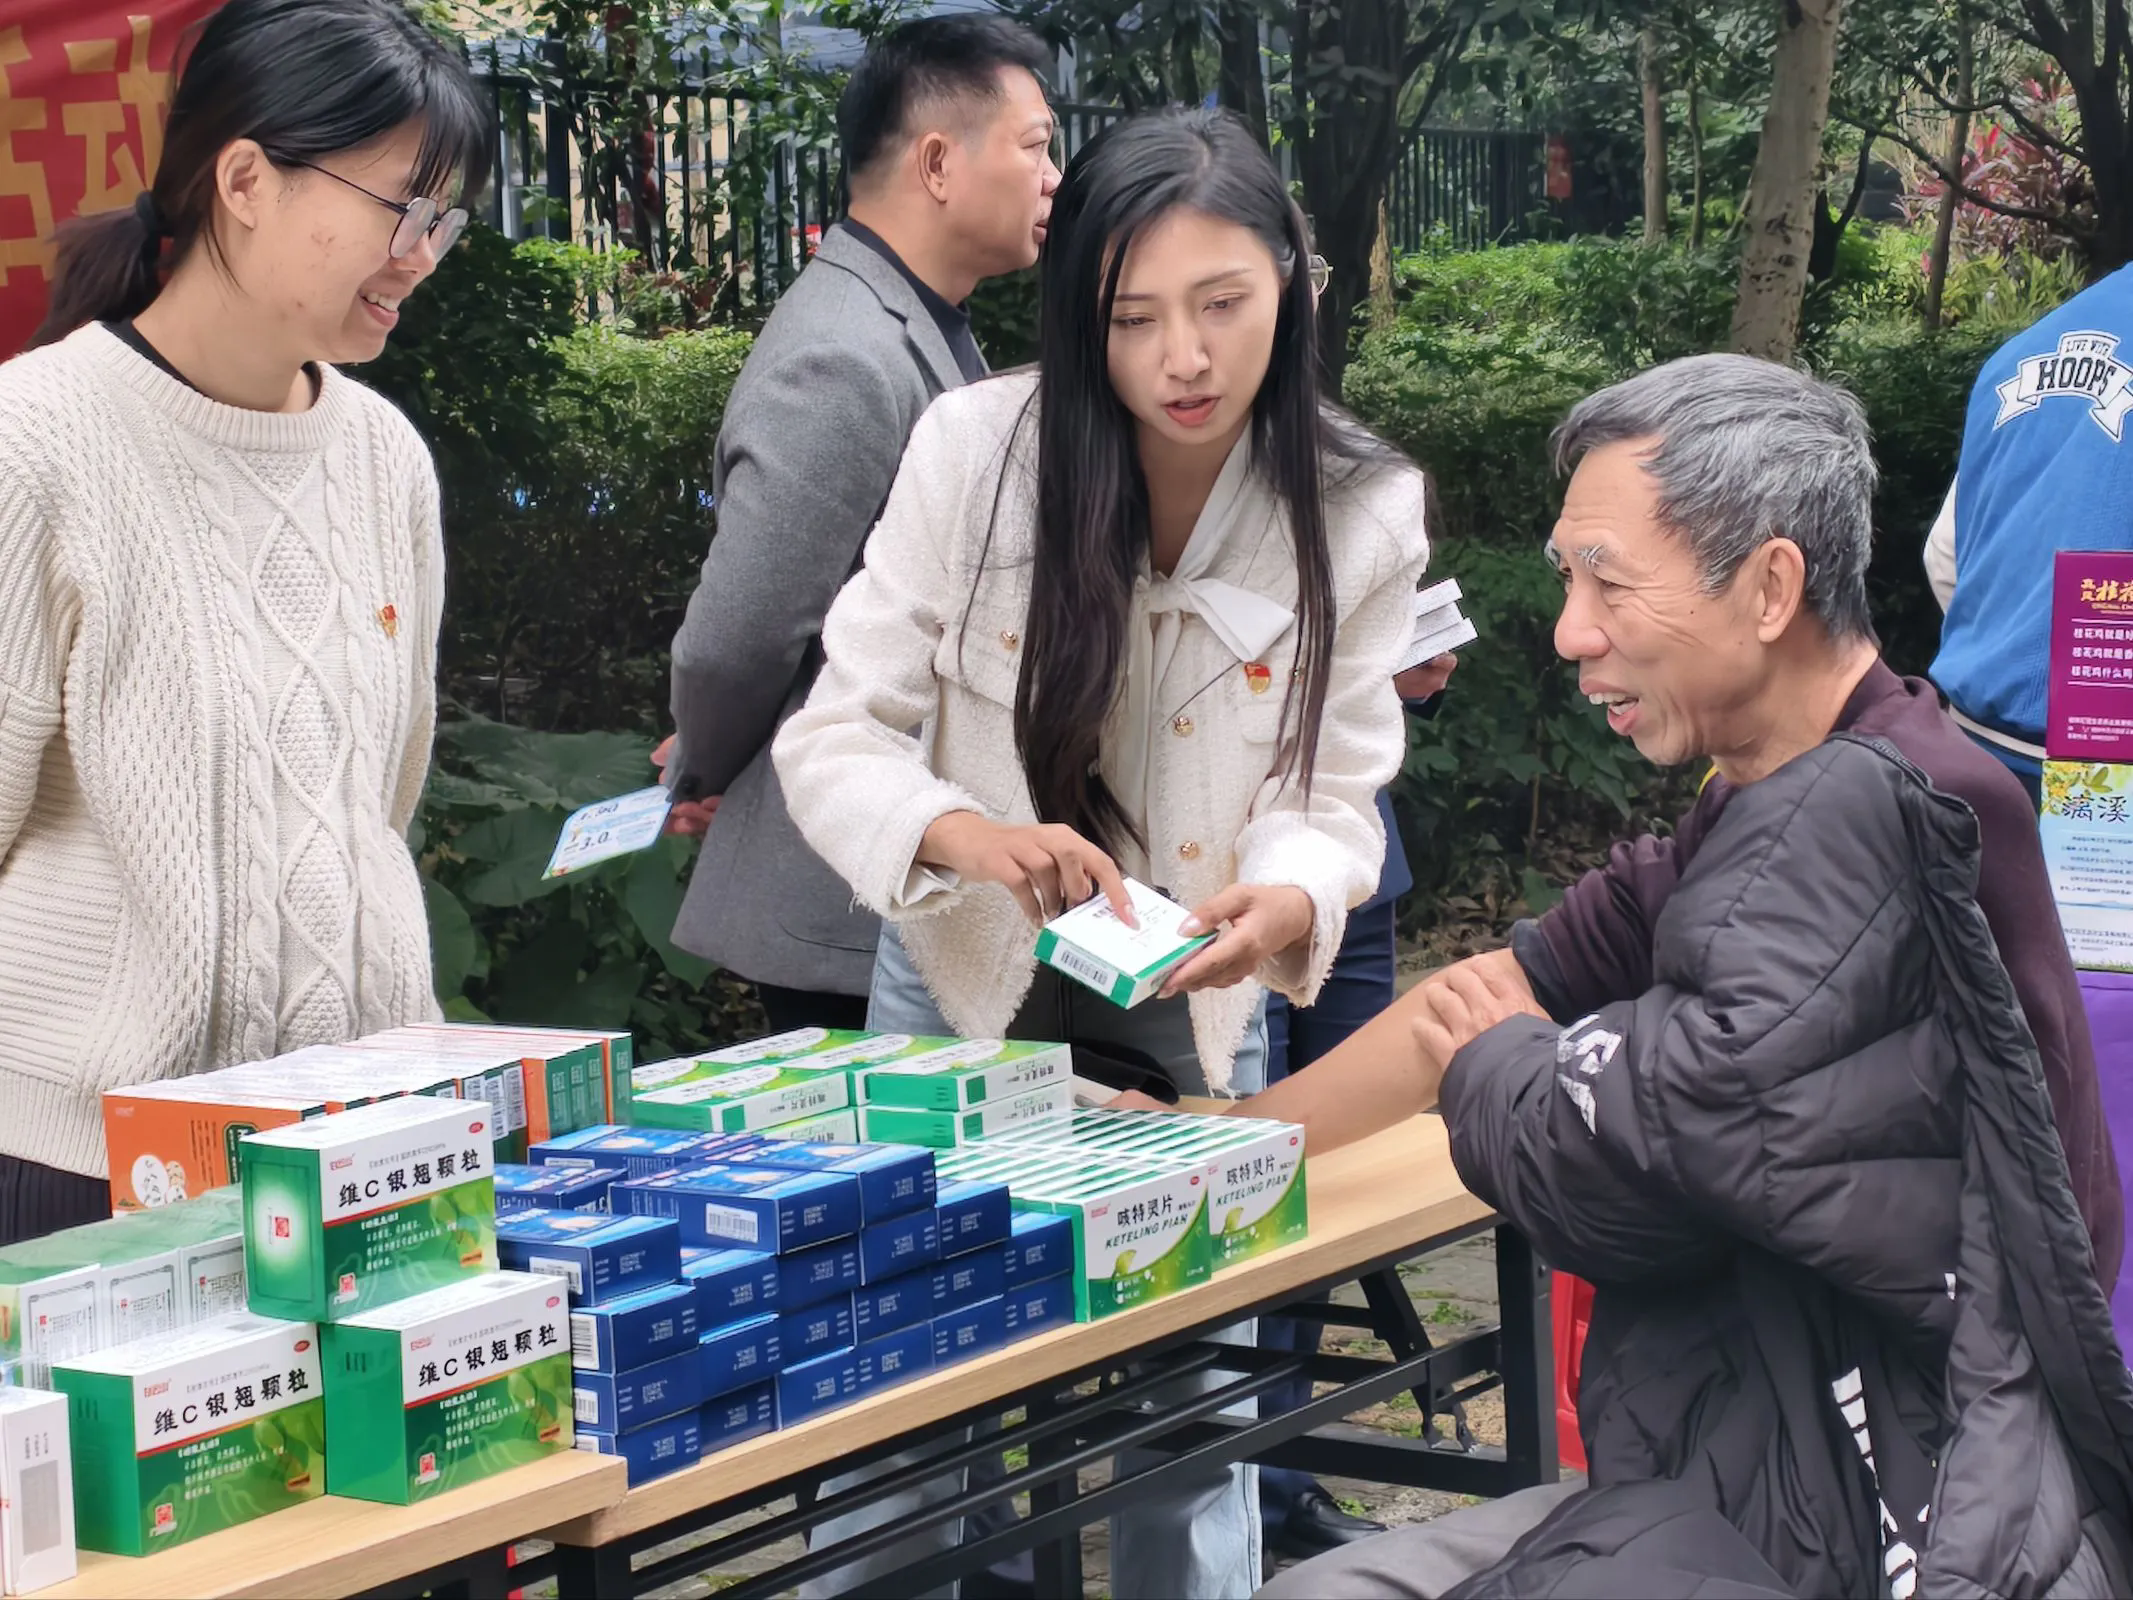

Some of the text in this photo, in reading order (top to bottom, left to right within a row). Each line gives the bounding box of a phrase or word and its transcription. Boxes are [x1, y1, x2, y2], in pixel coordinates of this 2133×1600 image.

[2036, 357, 2118, 396] HOOPS
[338, 1148, 481, 1208] 维C银翘颗粒
[1226, 1154, 1275, 1186] 咳特灵片
[1216, 1181, 1264, 1207] KETELING
[1265, 1174, 1289, 1193] PIAN
[1117, 1194, 1173, 1228] 咳特灵片
[1105, 1214, 1189, 1249] KETELING PIAN
[418, 1323, 558, 1388] 维C银翘颗粒
[153, 1368, 309, 1436] 维C银翘颗粒
